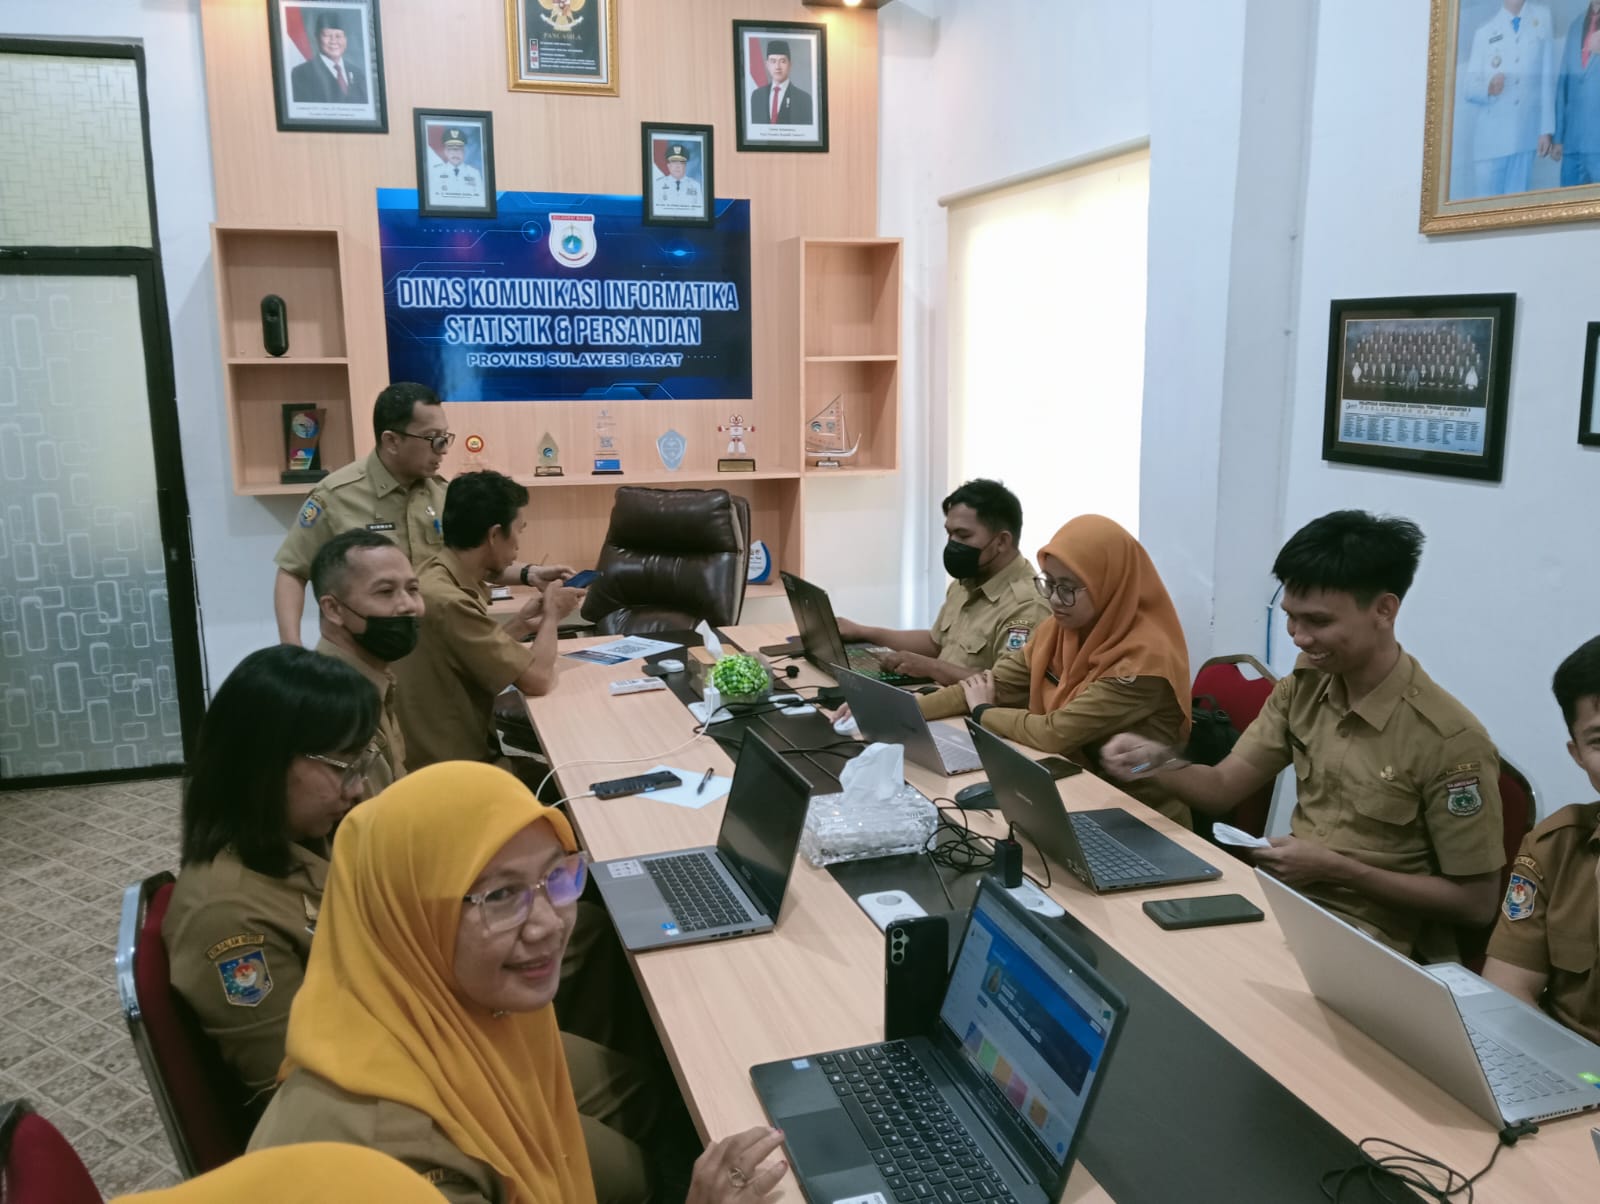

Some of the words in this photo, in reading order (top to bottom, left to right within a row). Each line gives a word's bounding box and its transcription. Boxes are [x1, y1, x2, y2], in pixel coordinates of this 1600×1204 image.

[398, 277, 467, 308] DINAS
[469, 278, 602, 310] KOMUNIKASI
[604, 279, 739, 311] INFORMATIKA
[445, 315, 552, 345] STATISTIK
[555, 316, 571, 345] &
[574, 315, 702, 345] PERSANDIAN
[467, 352, 545, 367] PROVINSI
[546, 352, 629, 367] SULAWESI
[630, 352, 683, 368] BARAT
